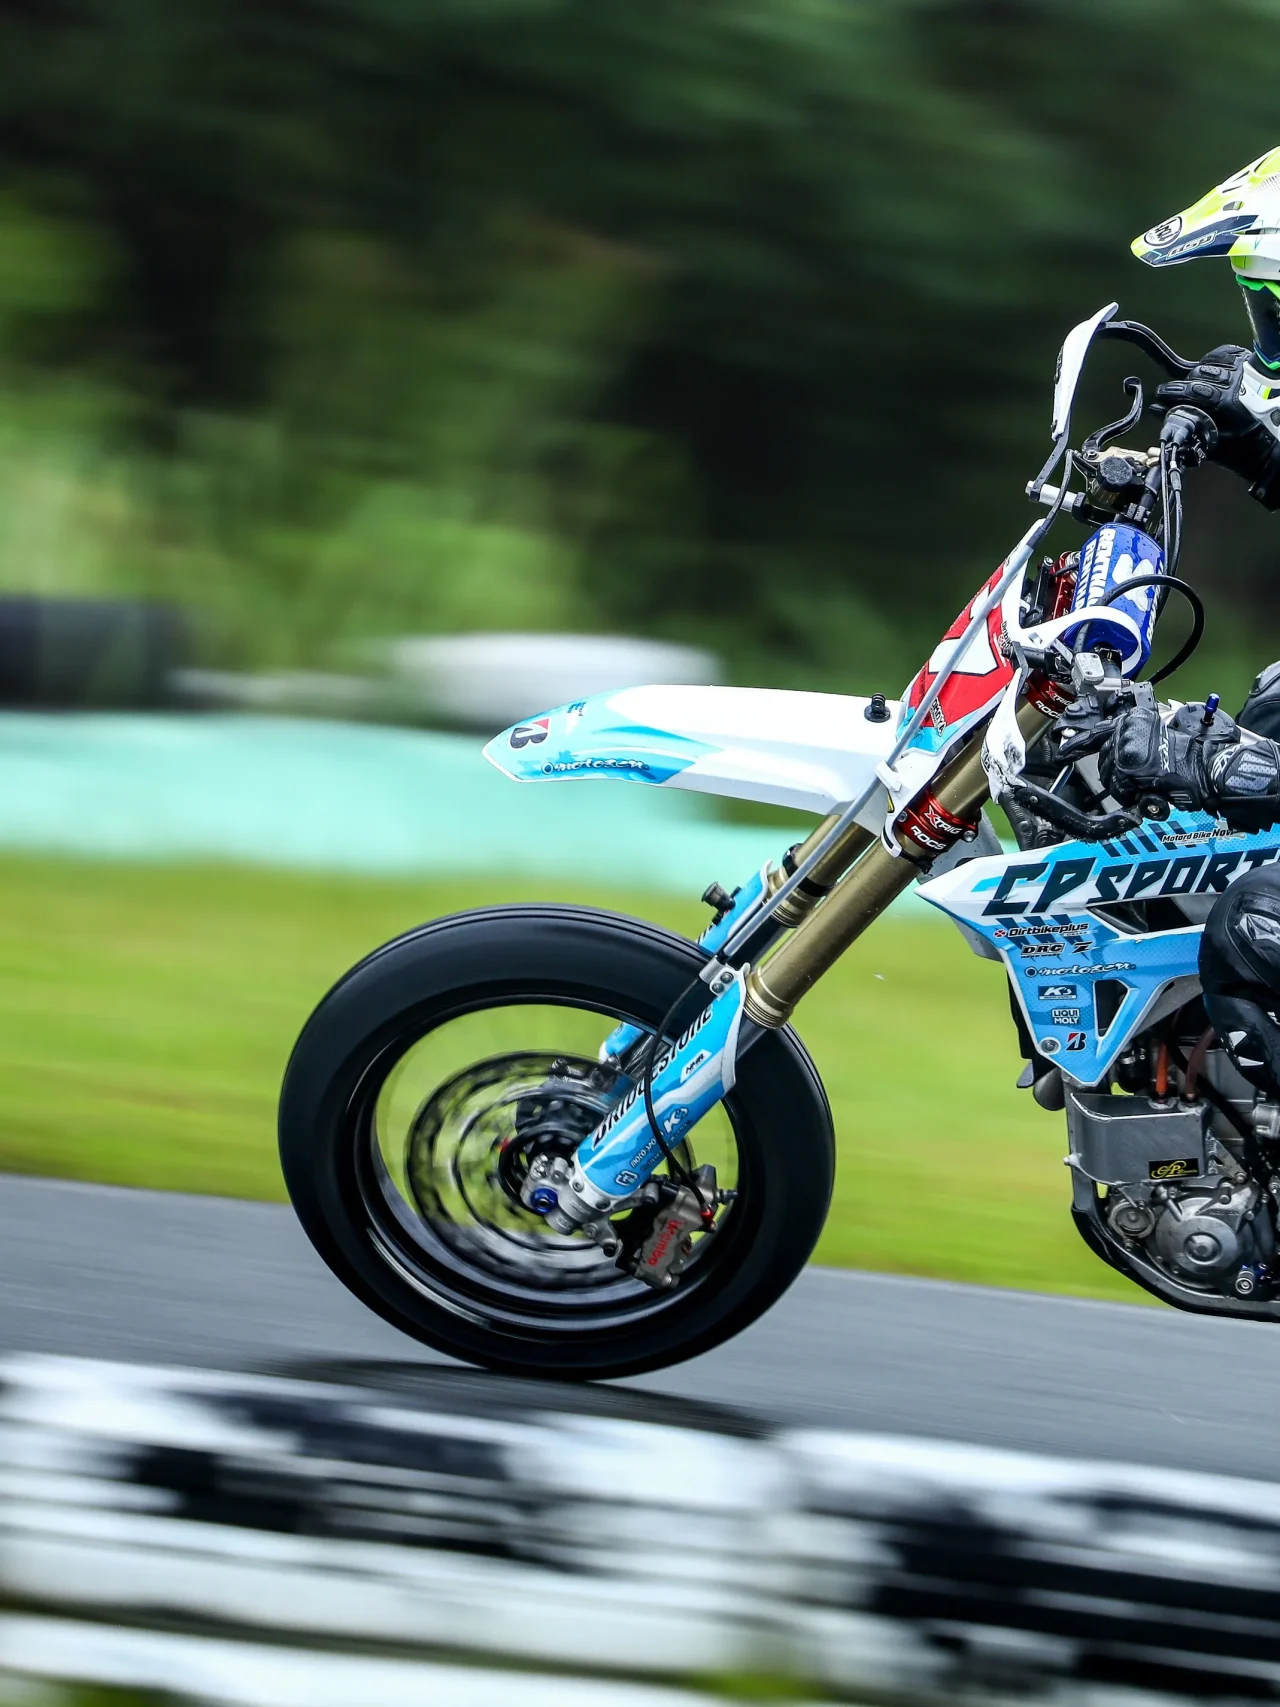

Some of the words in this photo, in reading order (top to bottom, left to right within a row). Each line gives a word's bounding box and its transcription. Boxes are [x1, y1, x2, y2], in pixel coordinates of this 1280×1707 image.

[1075, 537, 1098, 611] RENTHA
[931, 697, 947, 736] OMOYA
[924, 805, 962, 834] XTRIG
[910, 825, 947, 850] ROCS
[1162, 832, 1193, 843] Motard
[1193, 831, 1211, 840] Bike
[981, 857, 1097, 916] CP
[1008, 922, 1089, 937] Dirtbikeplus
[1022, 943, 1065, 955] DRC
[1053, 1009, 1080, 1017] LIQUI
[592, 1002, 714, 1151] BRIDESTONE
